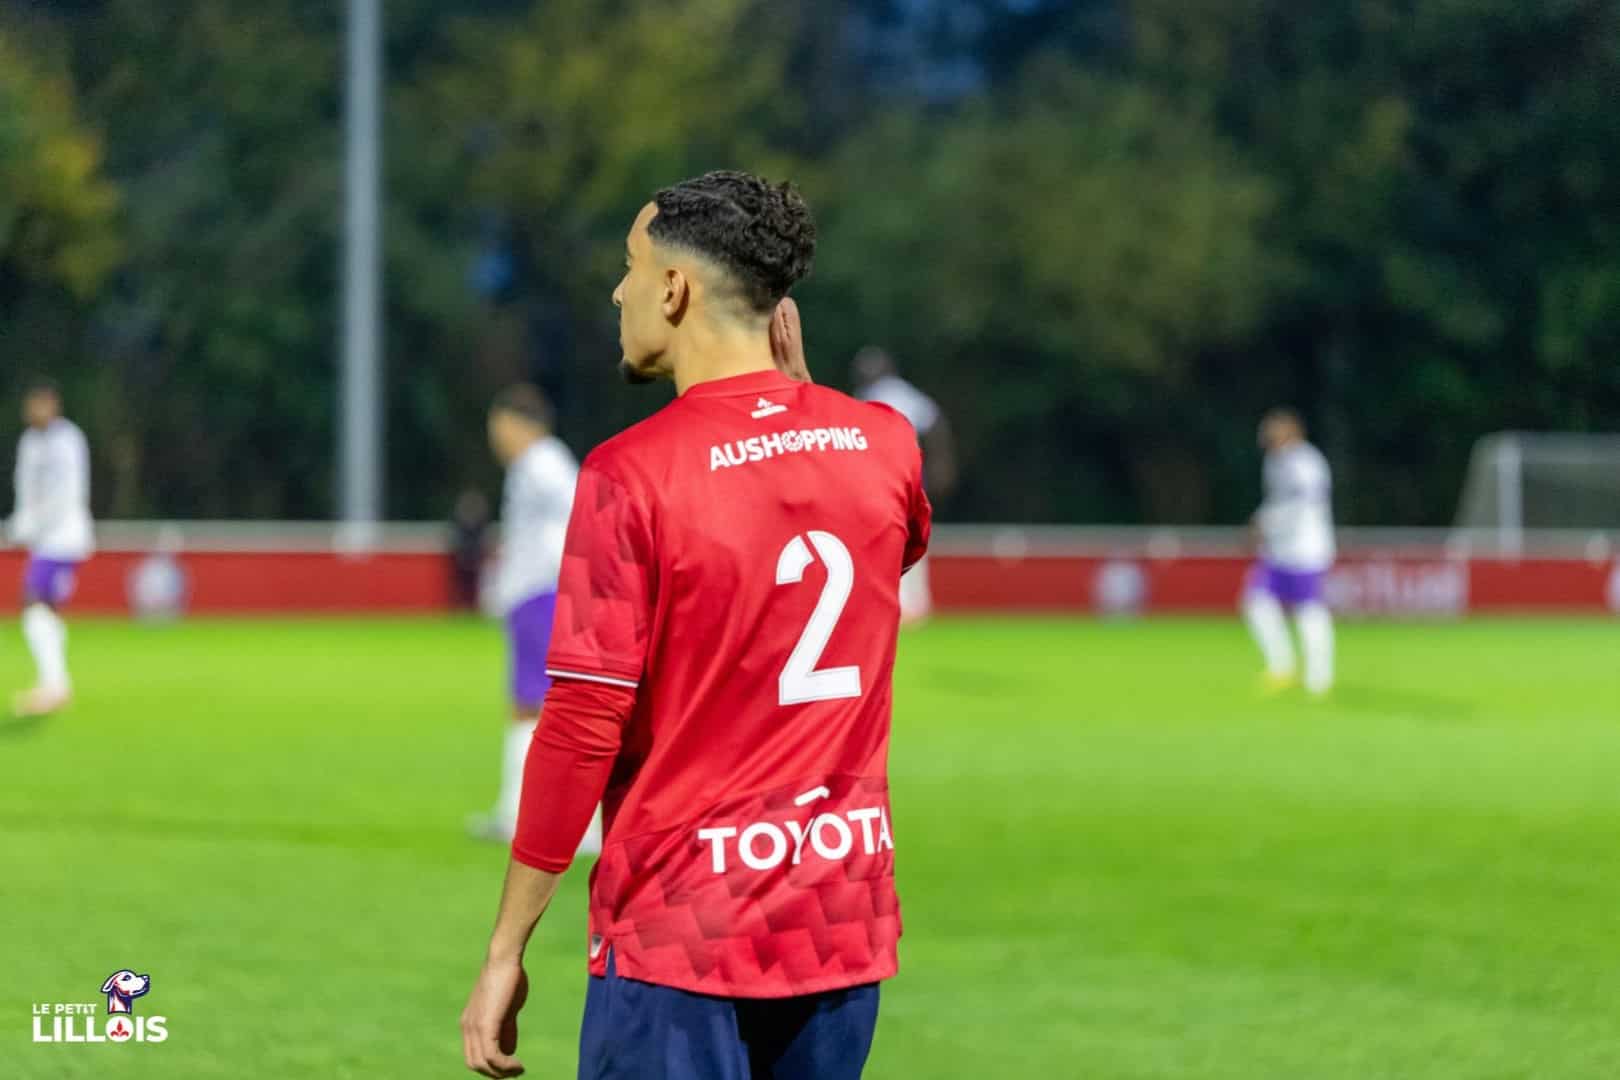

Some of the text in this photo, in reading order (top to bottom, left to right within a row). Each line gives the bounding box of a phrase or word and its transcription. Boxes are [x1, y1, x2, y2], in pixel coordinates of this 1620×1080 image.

[709, 427, 868, 471] AUSHOPPING
[775, 530, 862, 706] 2
[697, 805, 894, 874] TOYOTA
